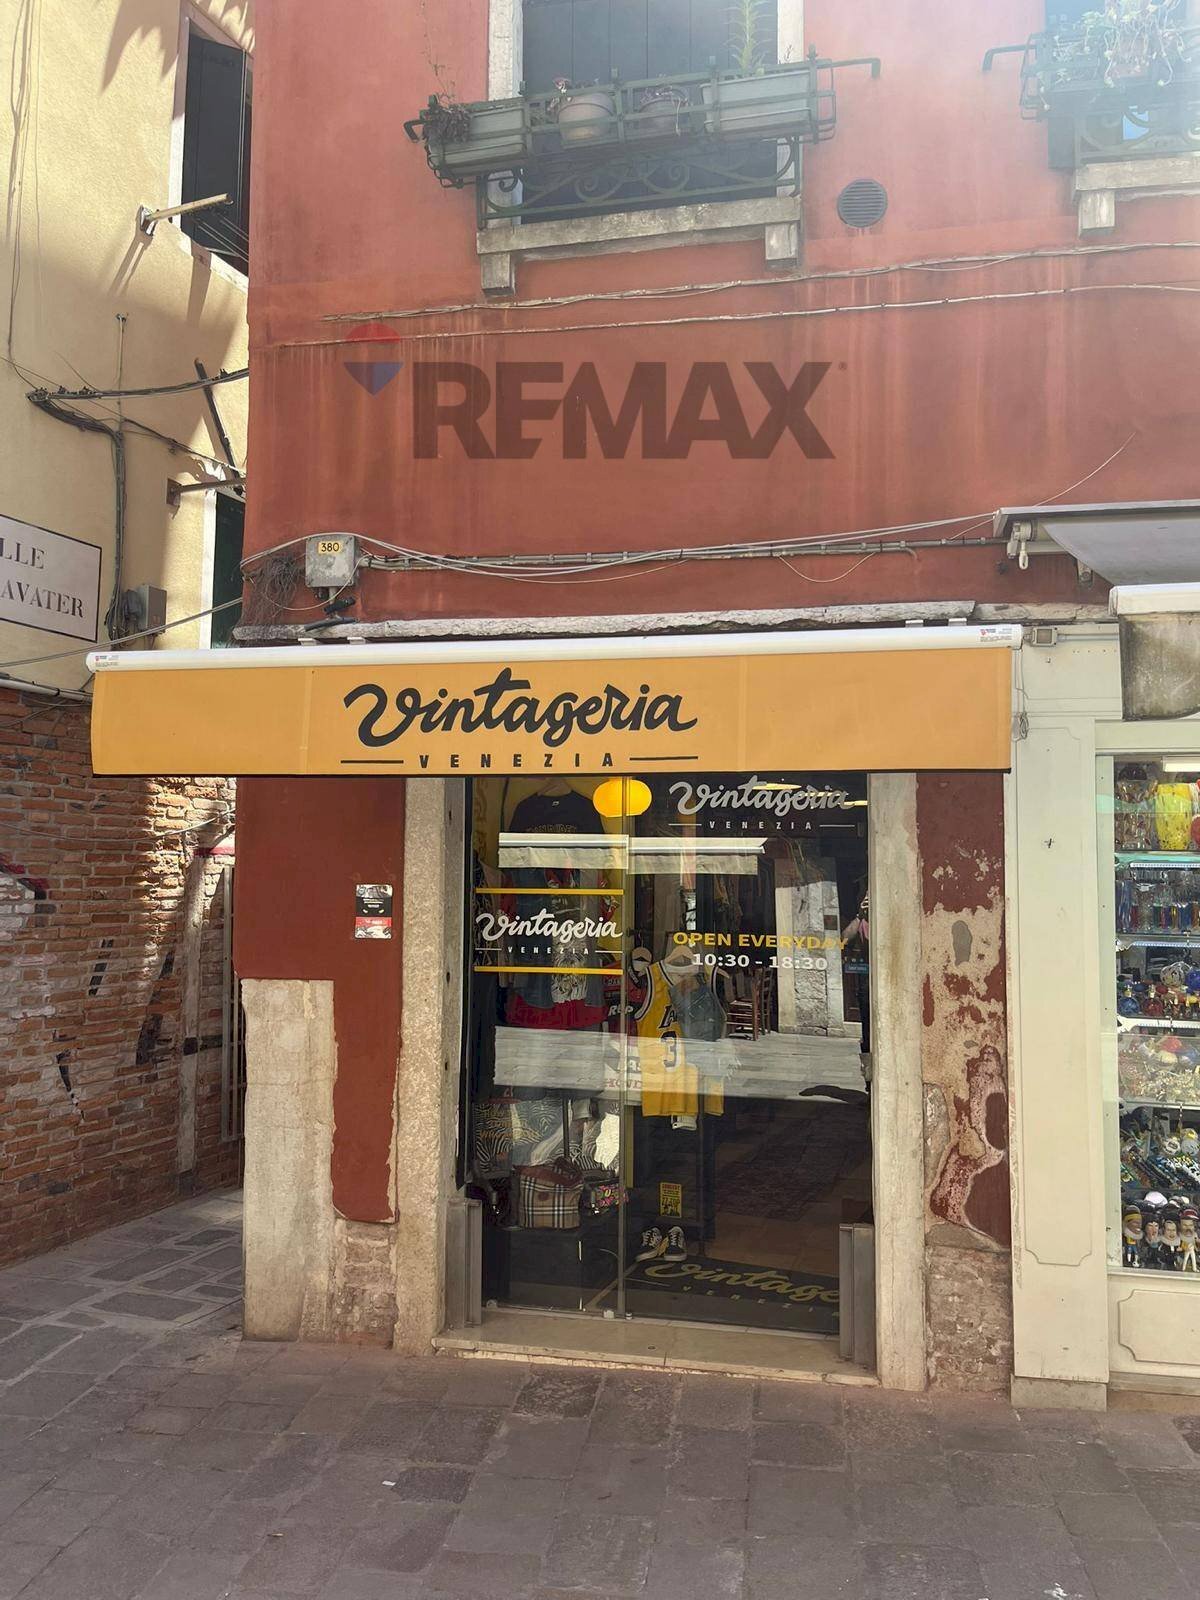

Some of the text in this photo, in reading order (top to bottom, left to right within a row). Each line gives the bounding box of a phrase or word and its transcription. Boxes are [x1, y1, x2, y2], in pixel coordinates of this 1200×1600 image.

[321, 542, 340, 552] 380
[1, 579, 84, 618] AVATER
[343, 667, 698, 747] Vintageria
[419, 752, 614, 769] VENEZIA
[669, 774, 855, 817] Vintageria
[709, 821, 812, 830] VENEZIA
[475, 908, 623, 943] Vintageria
[508, 946, 589, 954] VENEZIA
[673, 932, 848, 951] OPEN EVERYDAY
[692, 953, 750, 968] 10:30
[768, 955, 828, 970] 18:30
